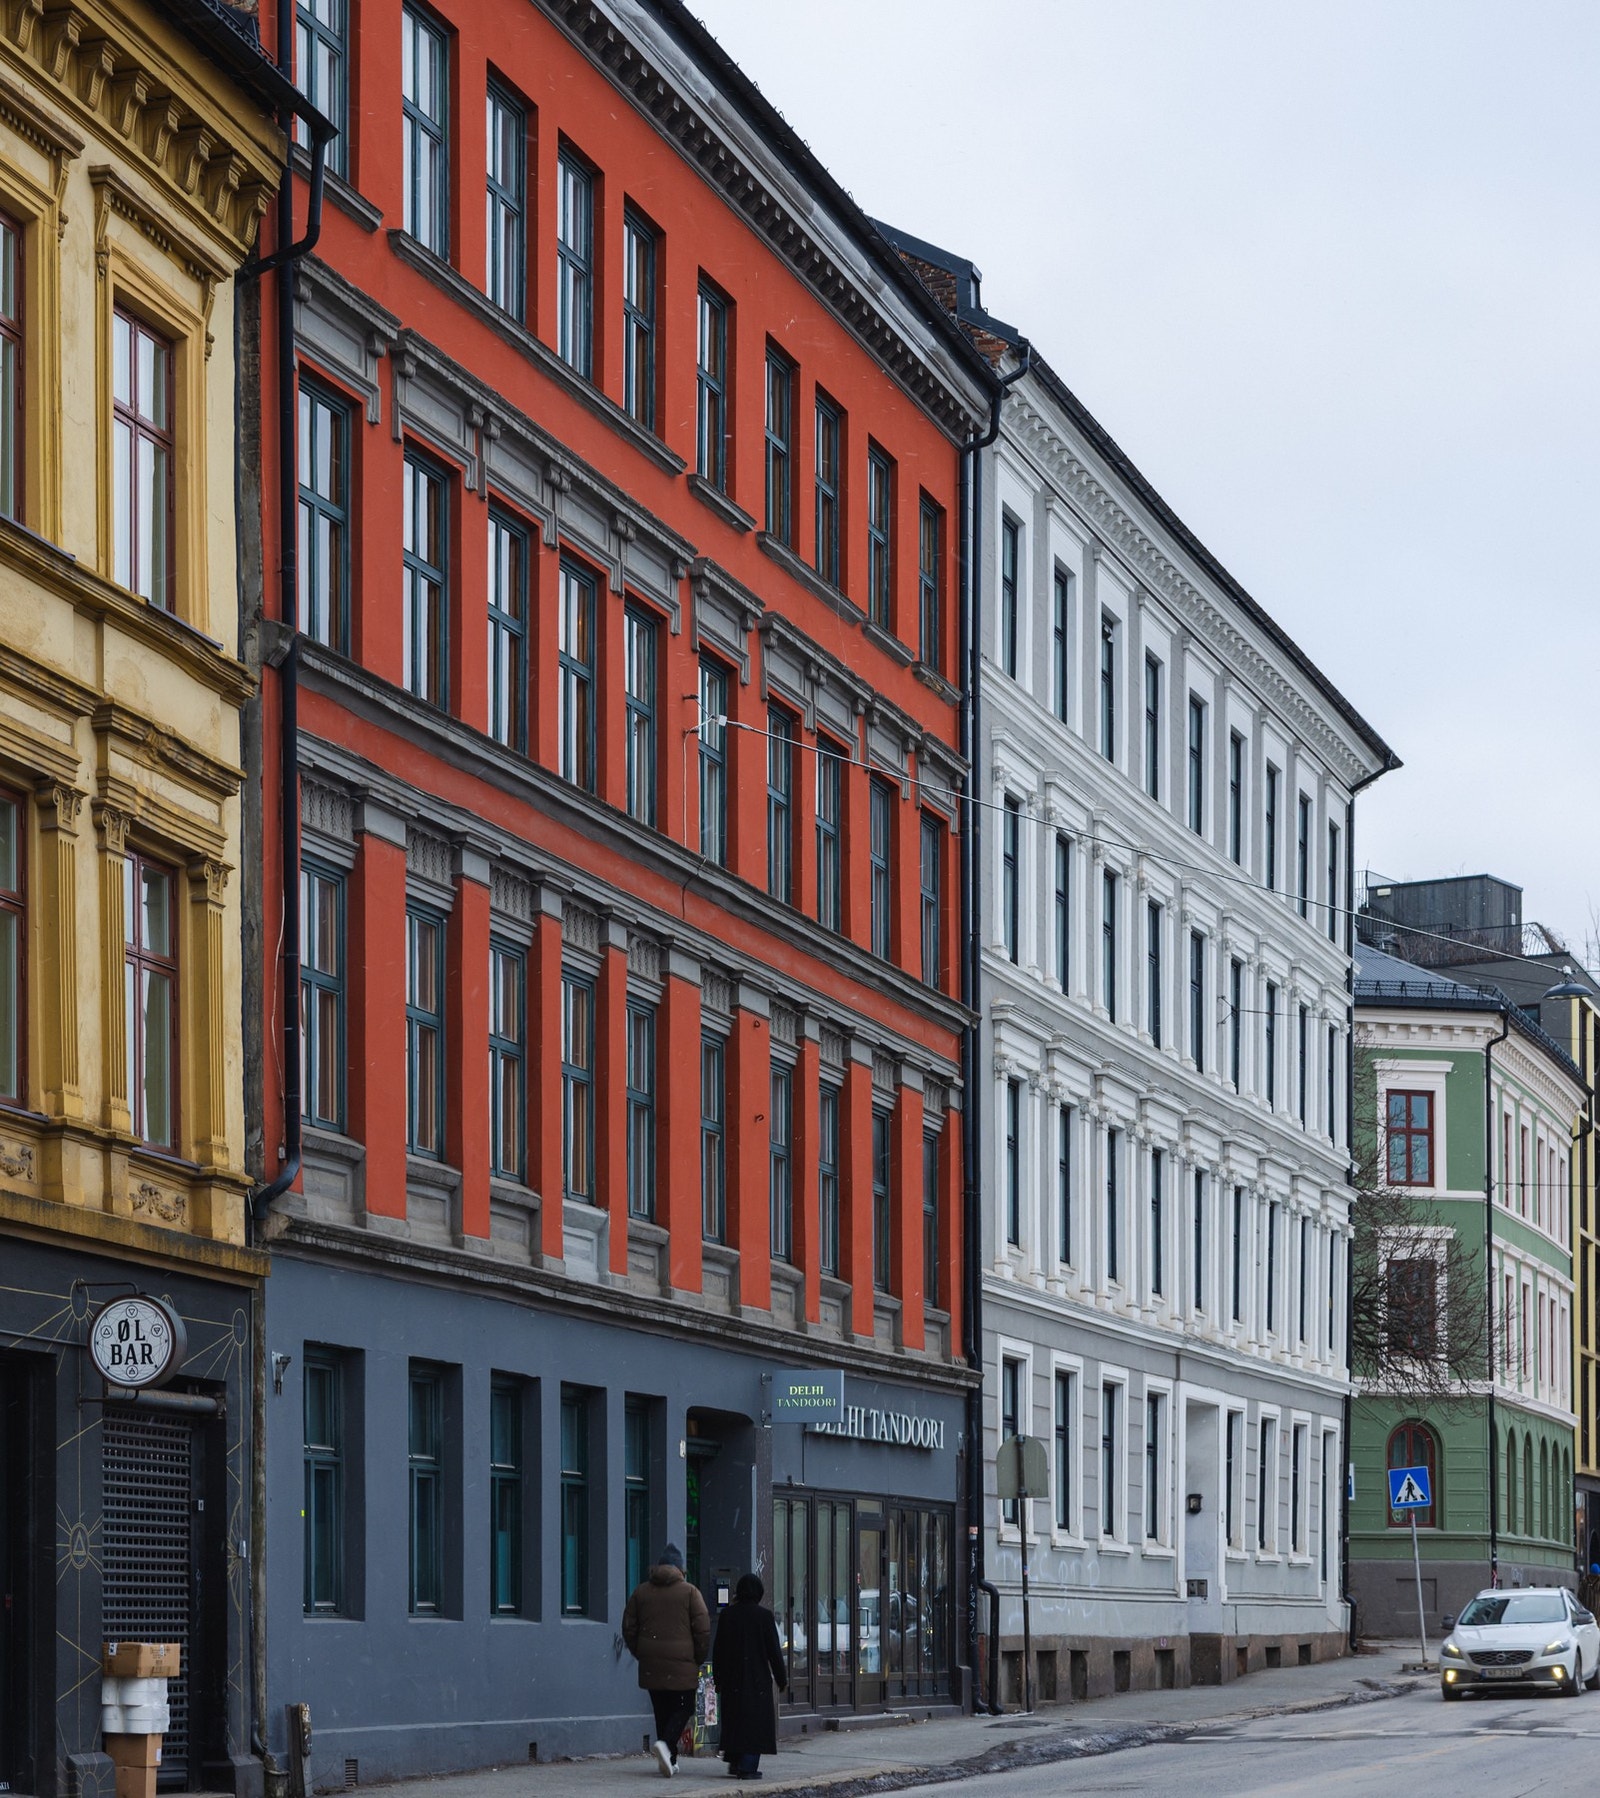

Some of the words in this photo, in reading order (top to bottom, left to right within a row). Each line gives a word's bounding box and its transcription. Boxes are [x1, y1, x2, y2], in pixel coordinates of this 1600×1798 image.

[117, 1318, 146, 1343] ØL
[110, 1343, 154, 1366] BAR
[789, 1385, 824, 1396] DELHI
[776, 1397, 836, 1408] TANDOORI
[869, 1407, 945, 1450] TANDOORI
